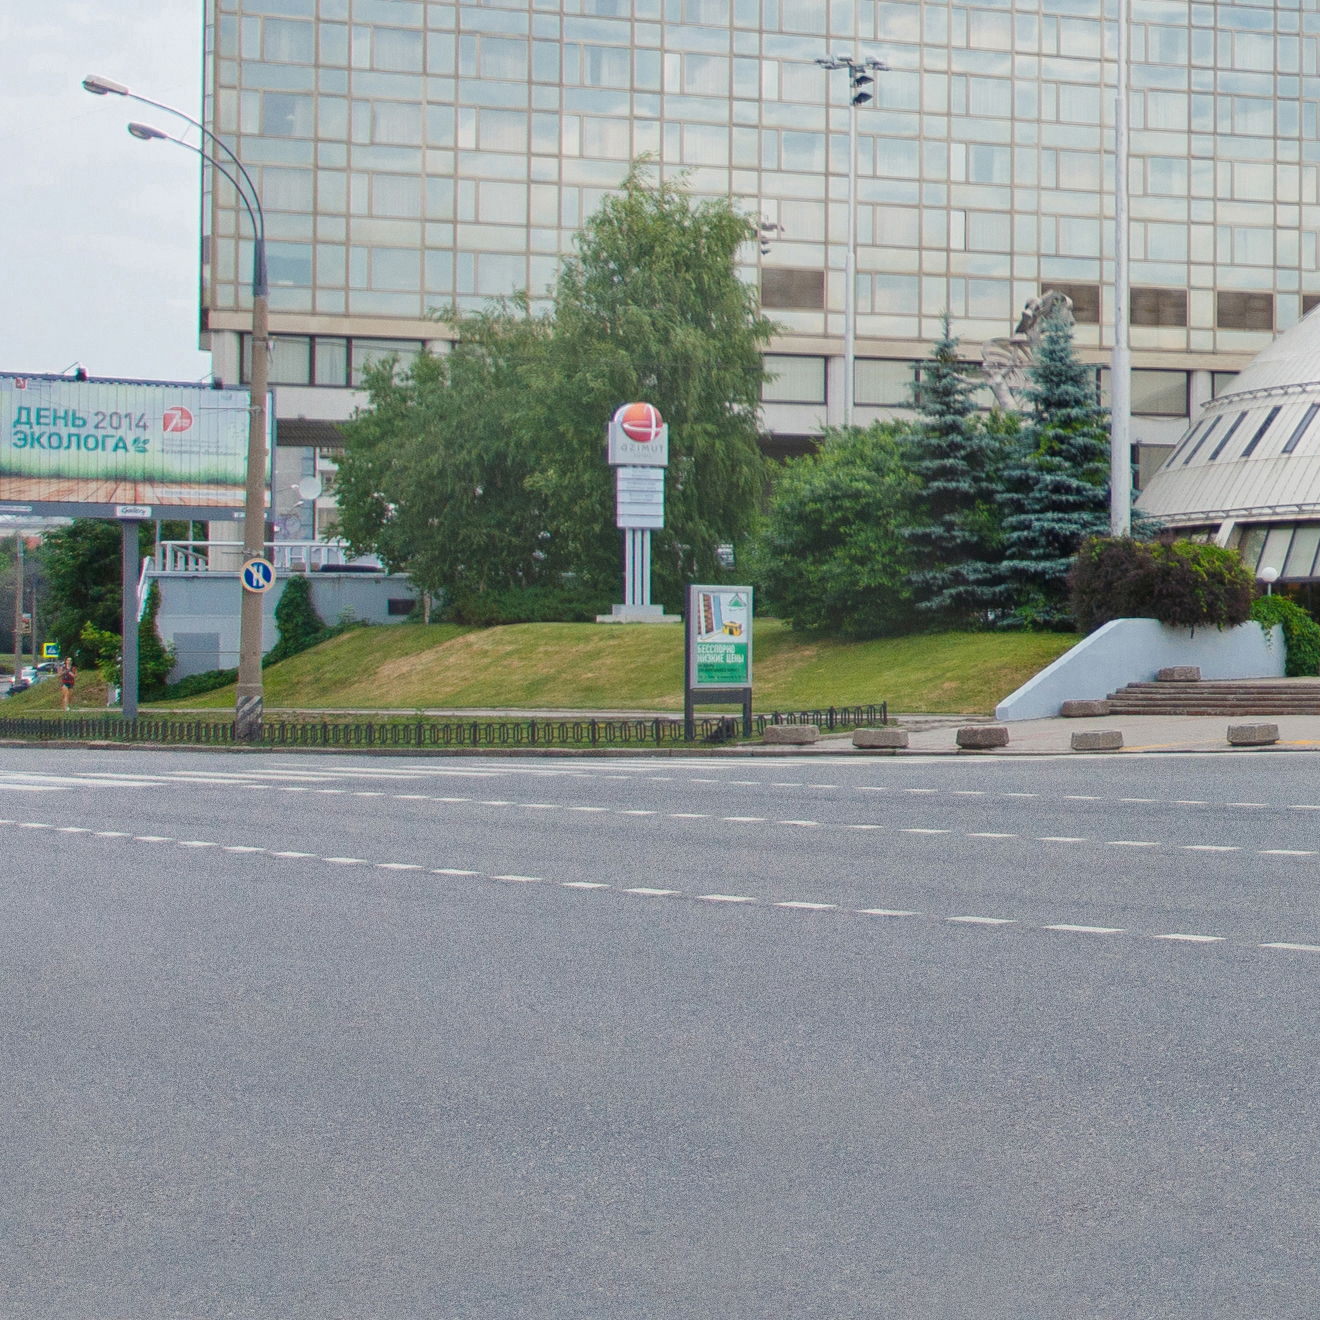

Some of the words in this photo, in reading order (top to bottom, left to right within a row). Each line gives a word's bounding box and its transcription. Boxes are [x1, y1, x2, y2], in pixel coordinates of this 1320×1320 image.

[13, 406, 87, 429] ДЕНЬ
[94, 411, 149, 431] 2014
[13, 430, 130, 453] ЭКОЛОГА
